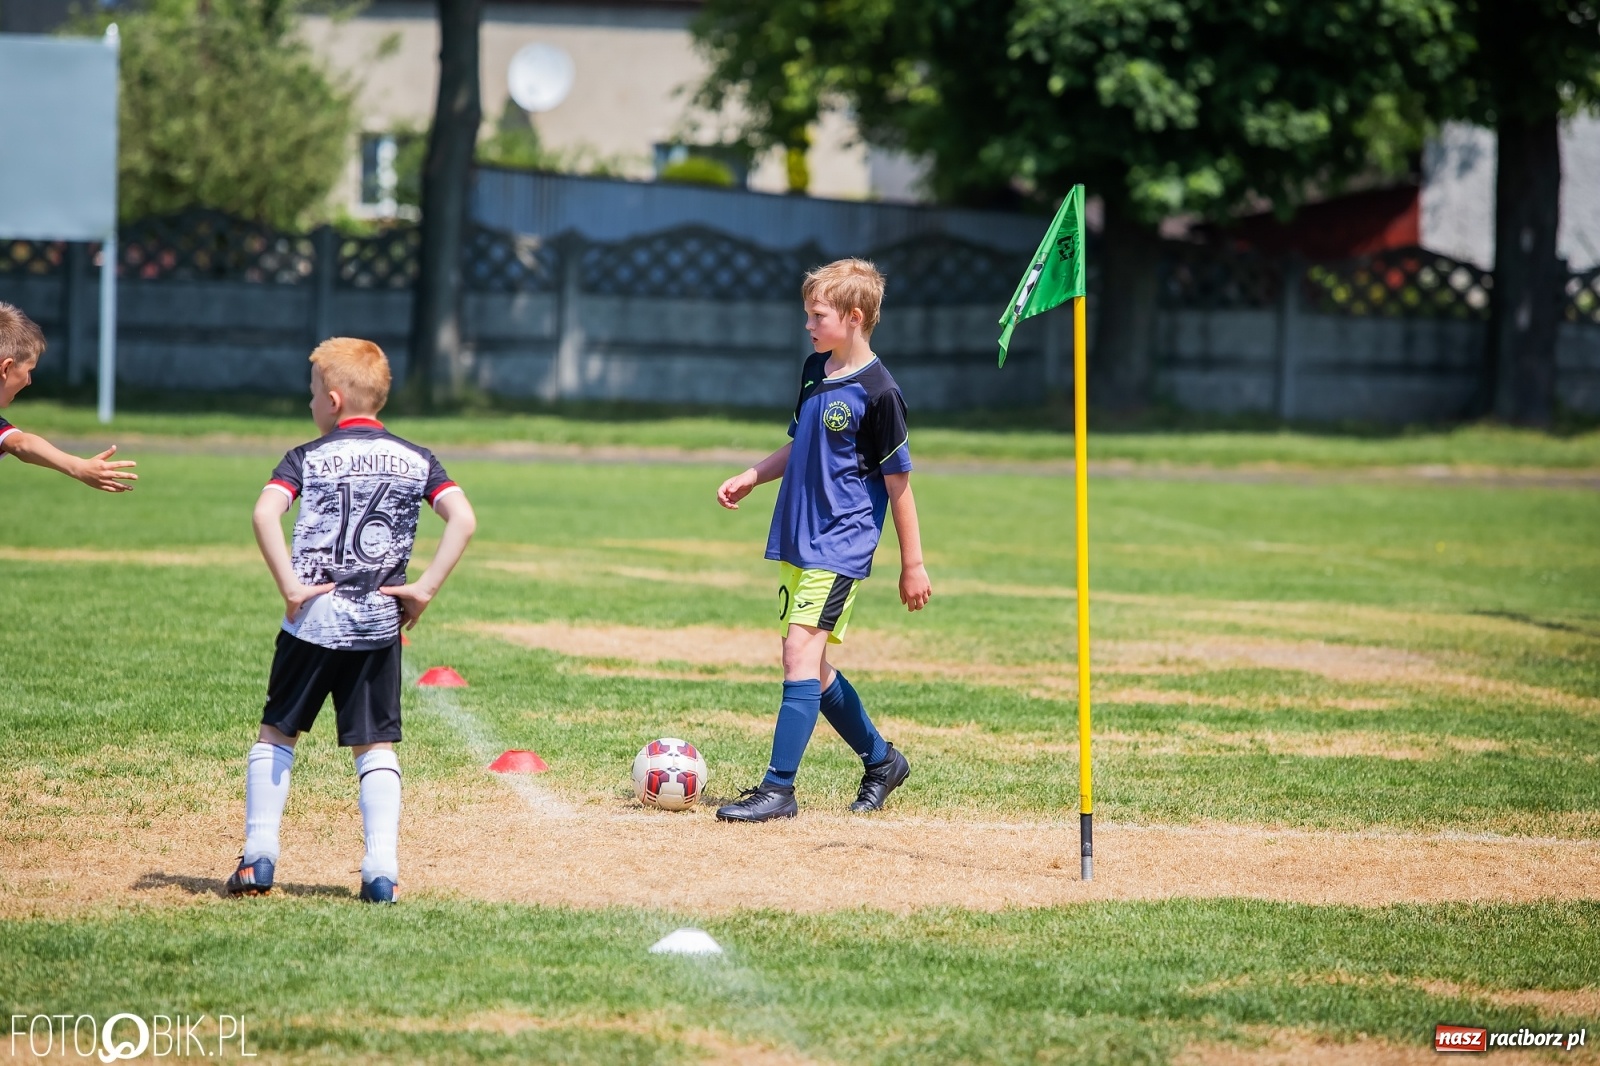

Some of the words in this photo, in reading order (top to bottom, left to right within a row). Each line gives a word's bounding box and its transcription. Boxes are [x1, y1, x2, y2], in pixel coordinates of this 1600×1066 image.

[320, 456, 343, 475] AP
[350, 454, 410, 475] UNITED
[332, 482, 395, 566] 16
